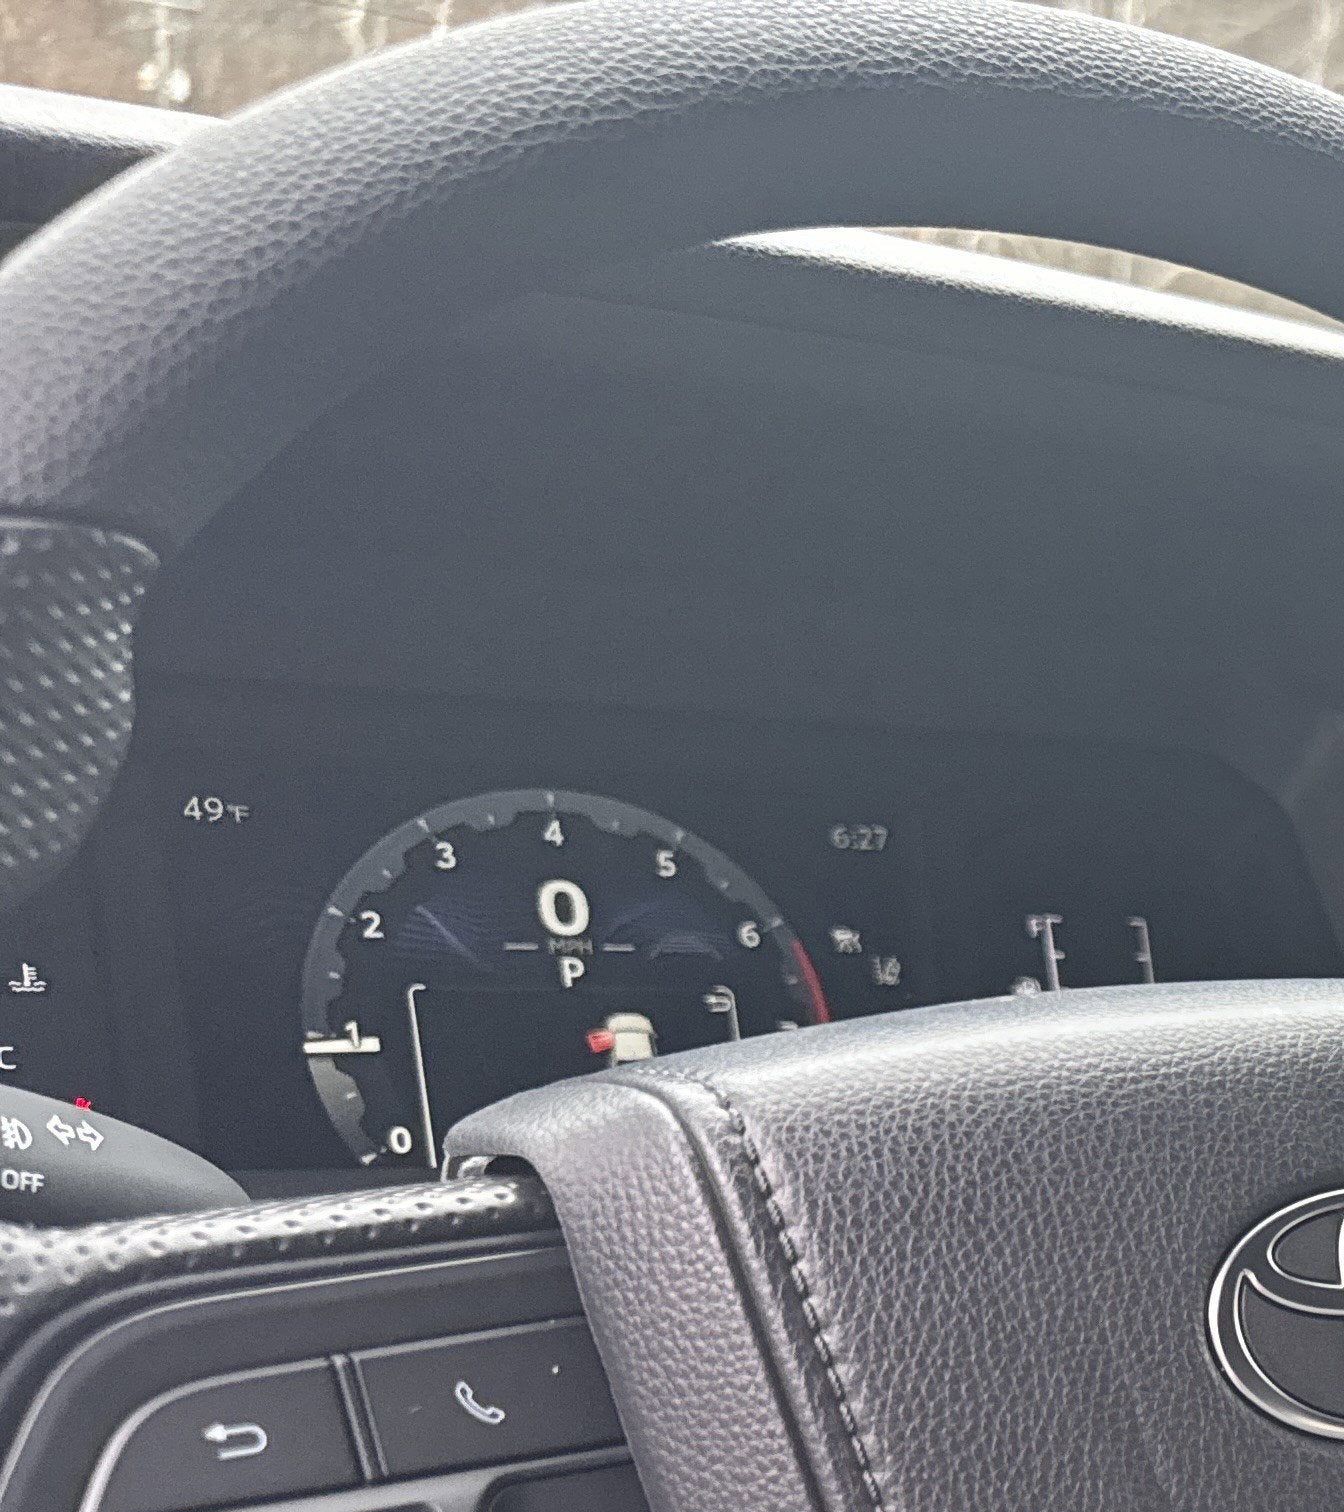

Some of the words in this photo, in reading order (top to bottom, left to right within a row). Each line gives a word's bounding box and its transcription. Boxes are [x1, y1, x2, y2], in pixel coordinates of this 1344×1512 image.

[543, 820, 564, 847] 4
[831, 824, 888, 851] 6:27
[435, 841, 457, 869] 3
[656, 850, 677, 877] 5
[537, 880, 590, 936] 0
[360, 910, 384, 939] 2
[739, 922, 760, 948] 6
[559, 956, 585, 989] P
[345, 1020, 360, 1047] 1
[389, 1126, 412, 1154] 0
[1, 1168, 45, 1193] OFF
